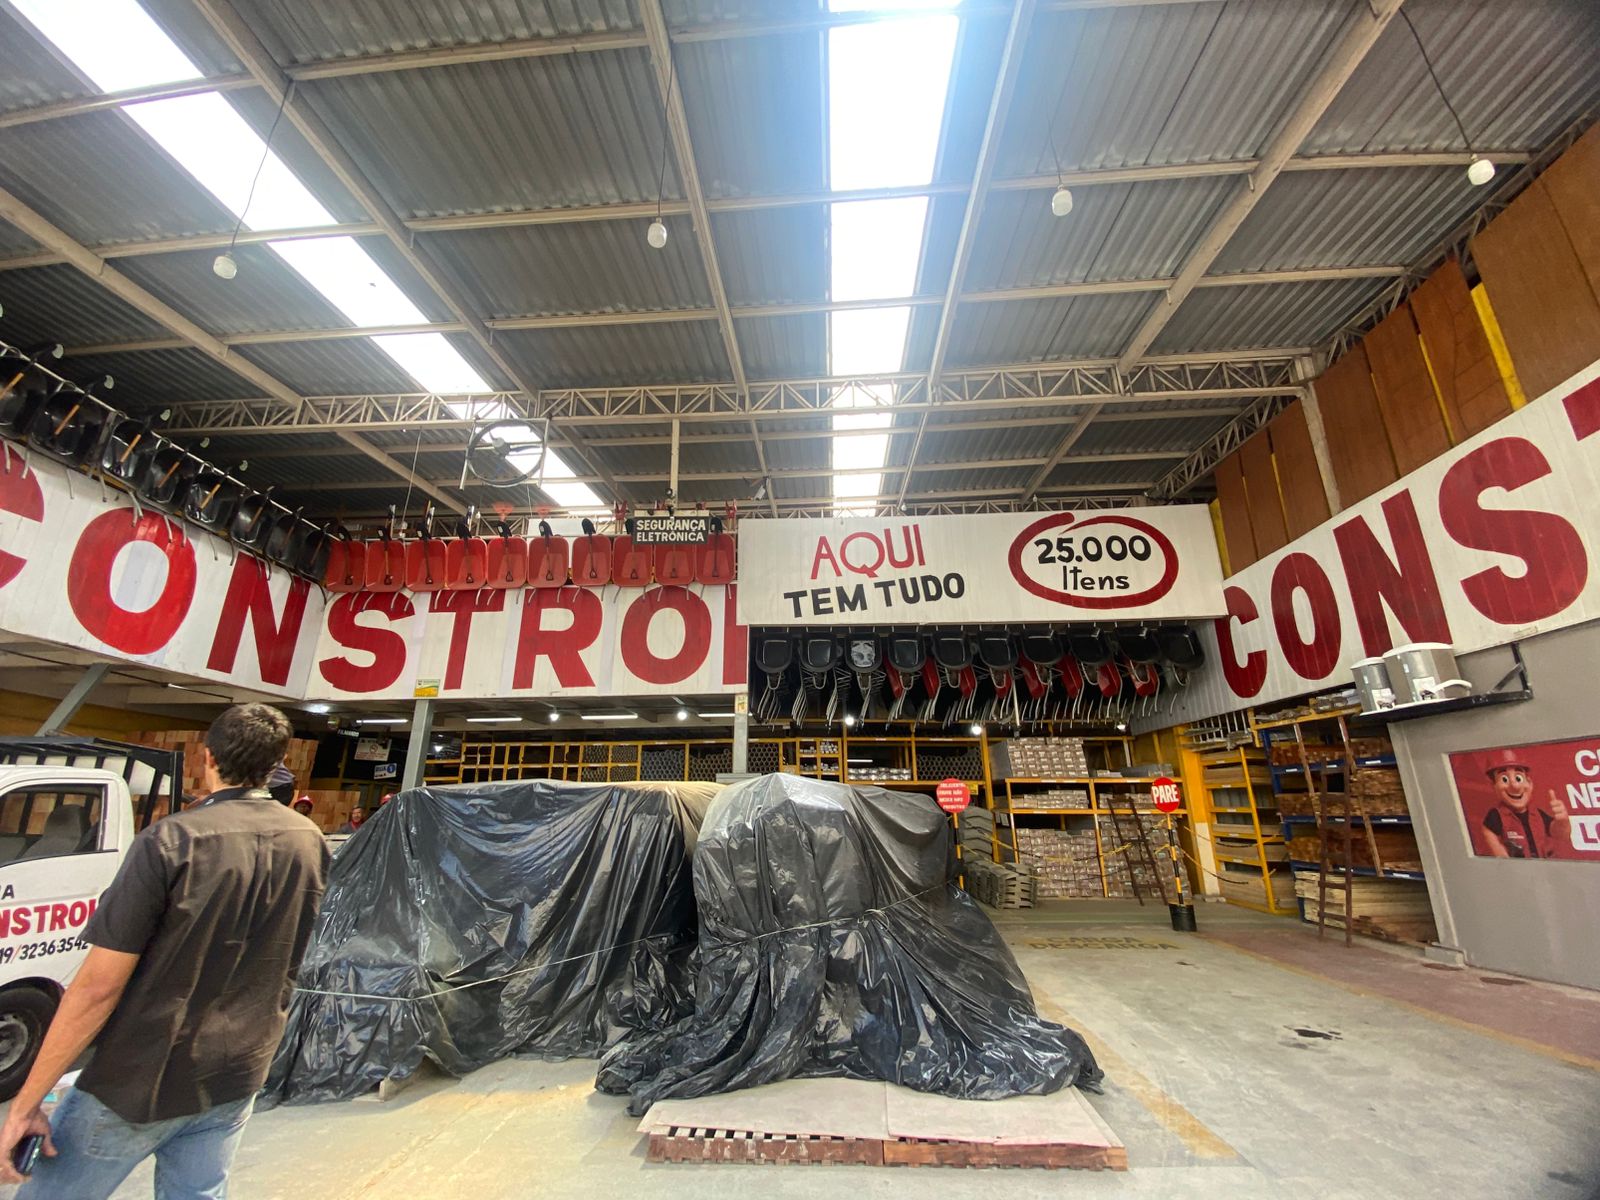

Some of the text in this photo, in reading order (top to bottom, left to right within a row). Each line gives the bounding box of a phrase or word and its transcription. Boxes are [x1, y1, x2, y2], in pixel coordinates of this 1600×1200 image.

[636, 519, 706, 531] SEGURANÇA
[636, 531, 705, 542] ELETRÔNICA
[1215, 376, 1600, 698] CONS
[810, 524, 926, 580] AQUI
[1034, 535, 1152, 564] 25.000
[1062, 565, 1130, 590] Itens
[783, 572, 965, 618] TEM TUDO
[1574, 749, 1600, 777] C
[1151, 784, 1180, 805] PARE
[1028, 942, 1181, 950] DESCARGA
[1045, 936, 1142, 944] CARGA
